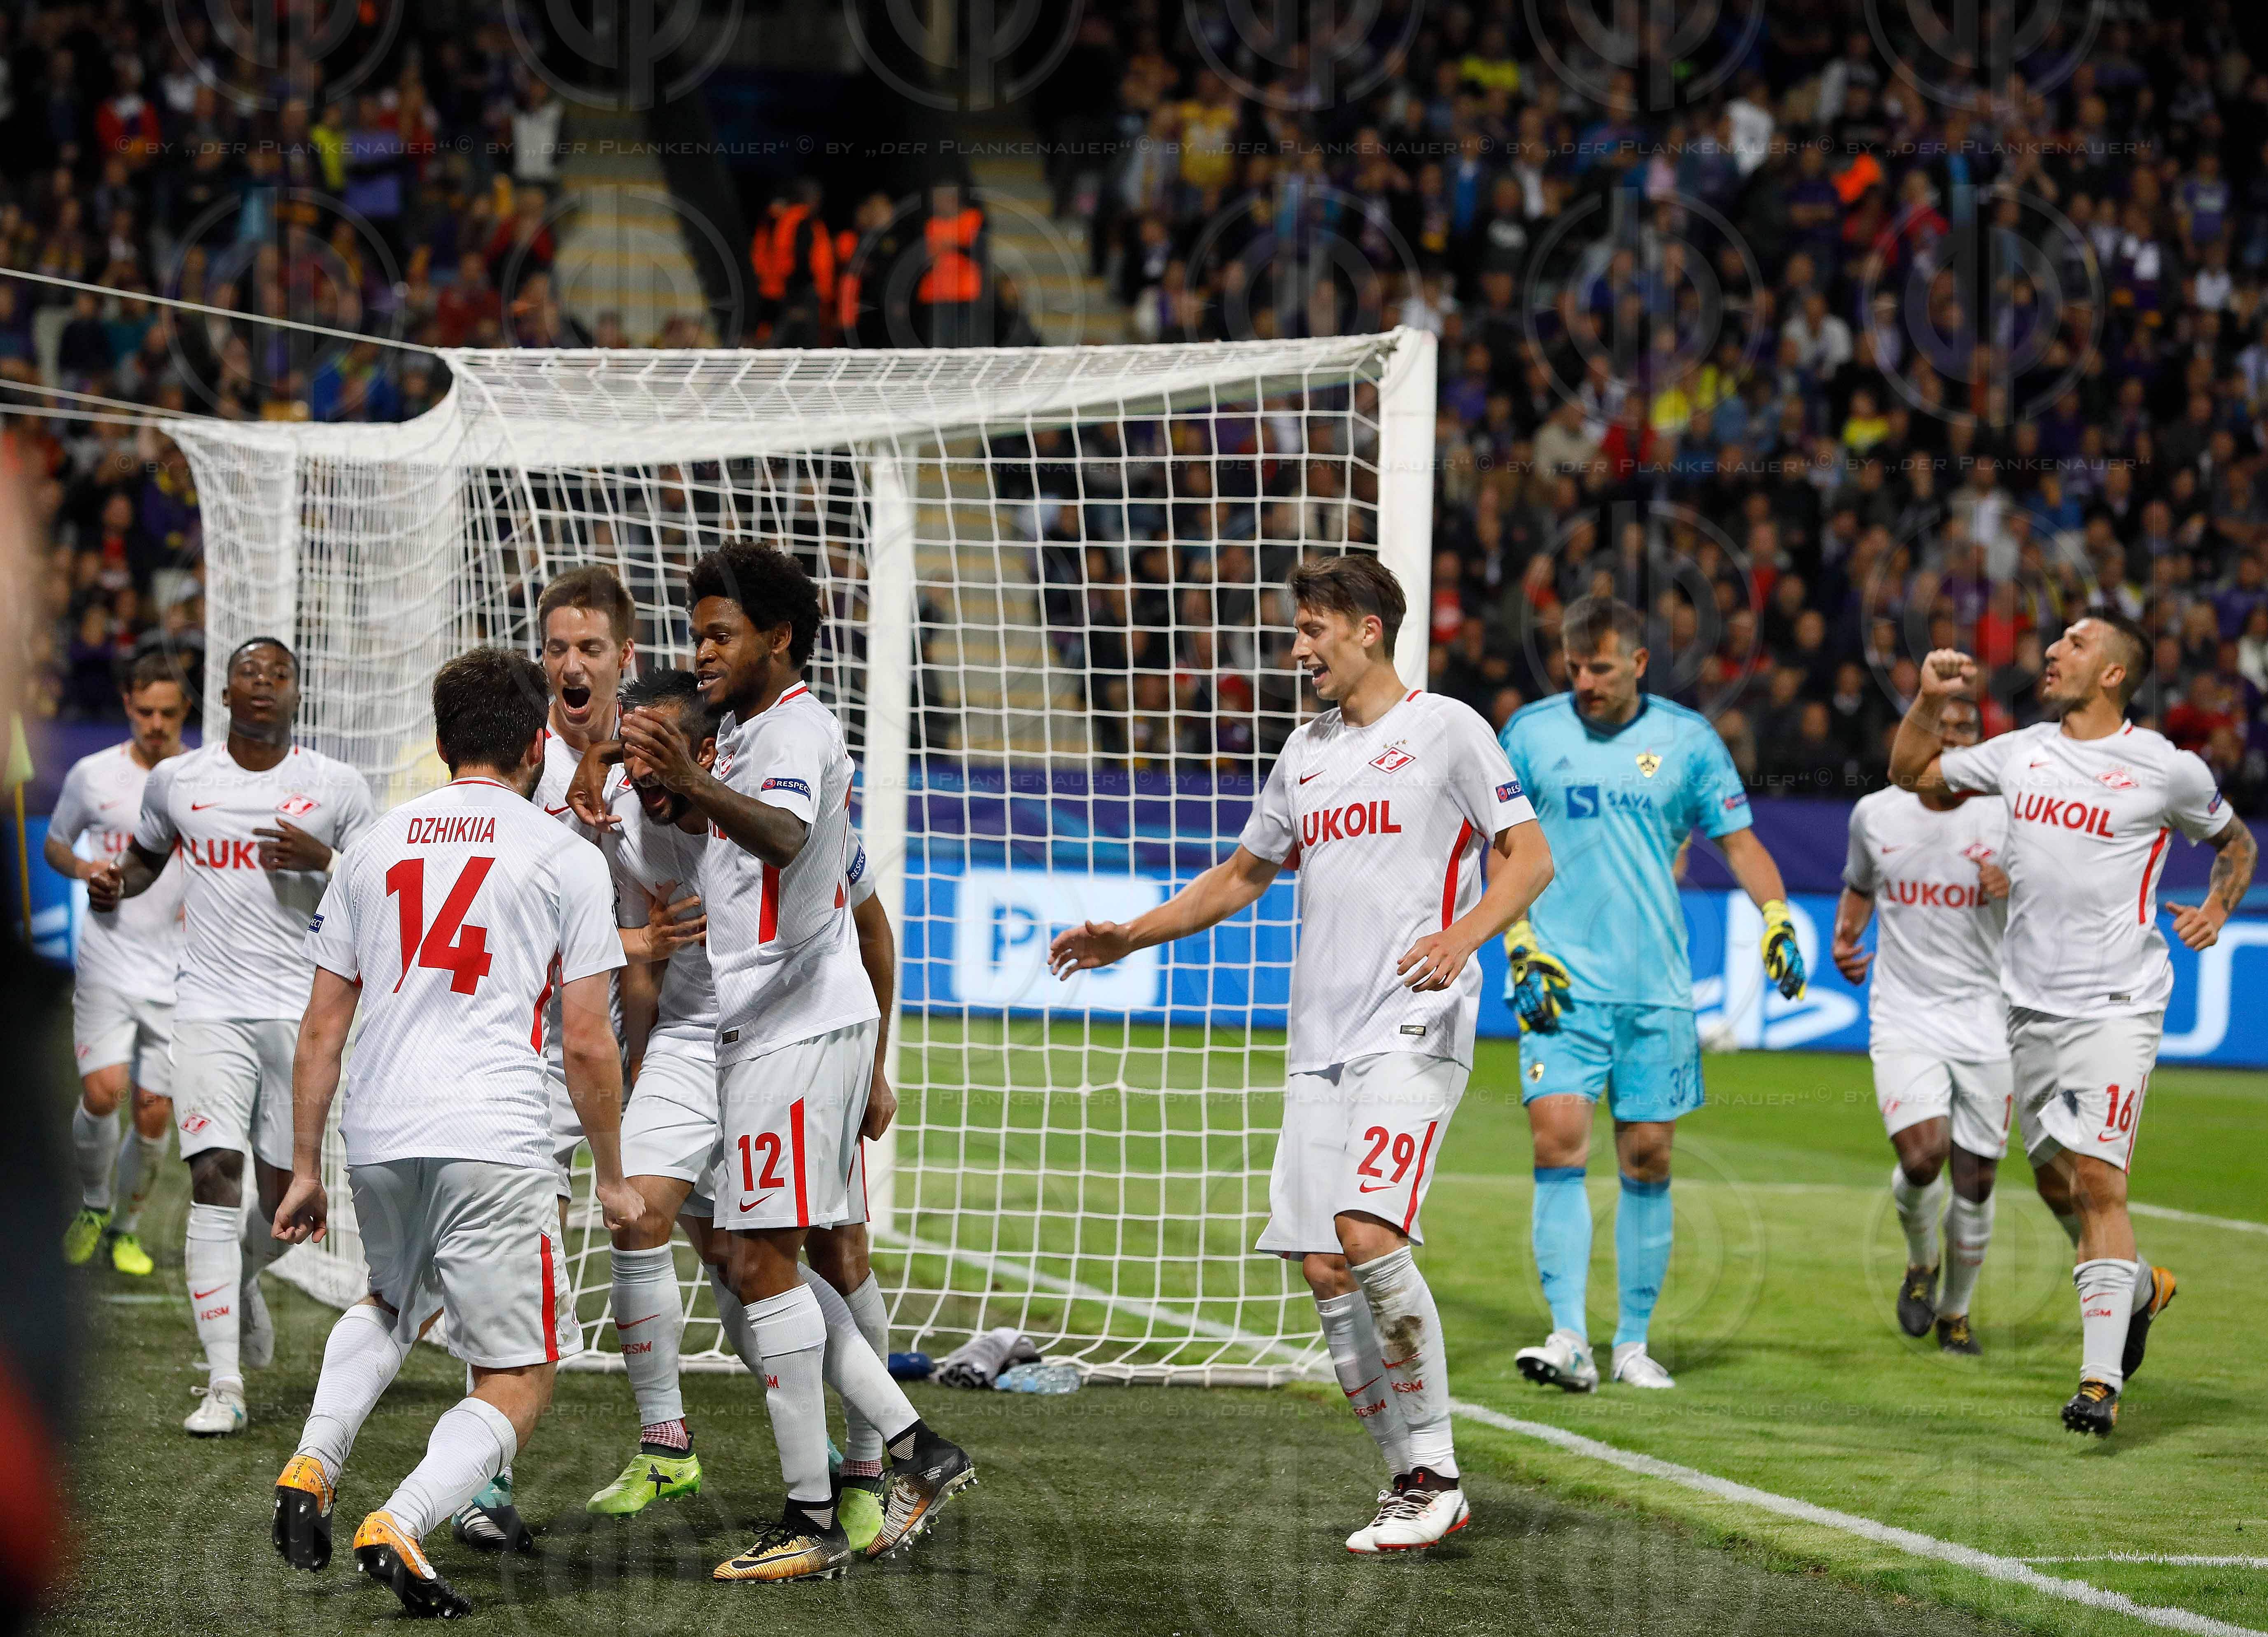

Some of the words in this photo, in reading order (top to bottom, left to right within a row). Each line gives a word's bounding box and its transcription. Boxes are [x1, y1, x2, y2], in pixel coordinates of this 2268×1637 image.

[1507, 784, 1521, 796] RES
[1607, 790, 1653, 811] SAVA
[407, 817, 495, 844] DZHIKIIA
[2014, 791, 2114, 838] LUKOIL
[190, 838, 257, 870] LUK
[1884, 880, 1989, 907] LUKOIL
[386, 856, 496, 996] 14
[2105, 1083, 2135, 1132] 16
[737, 1132, 785, 1192] 12
[1357, 1126, 1415, 1183] 29
